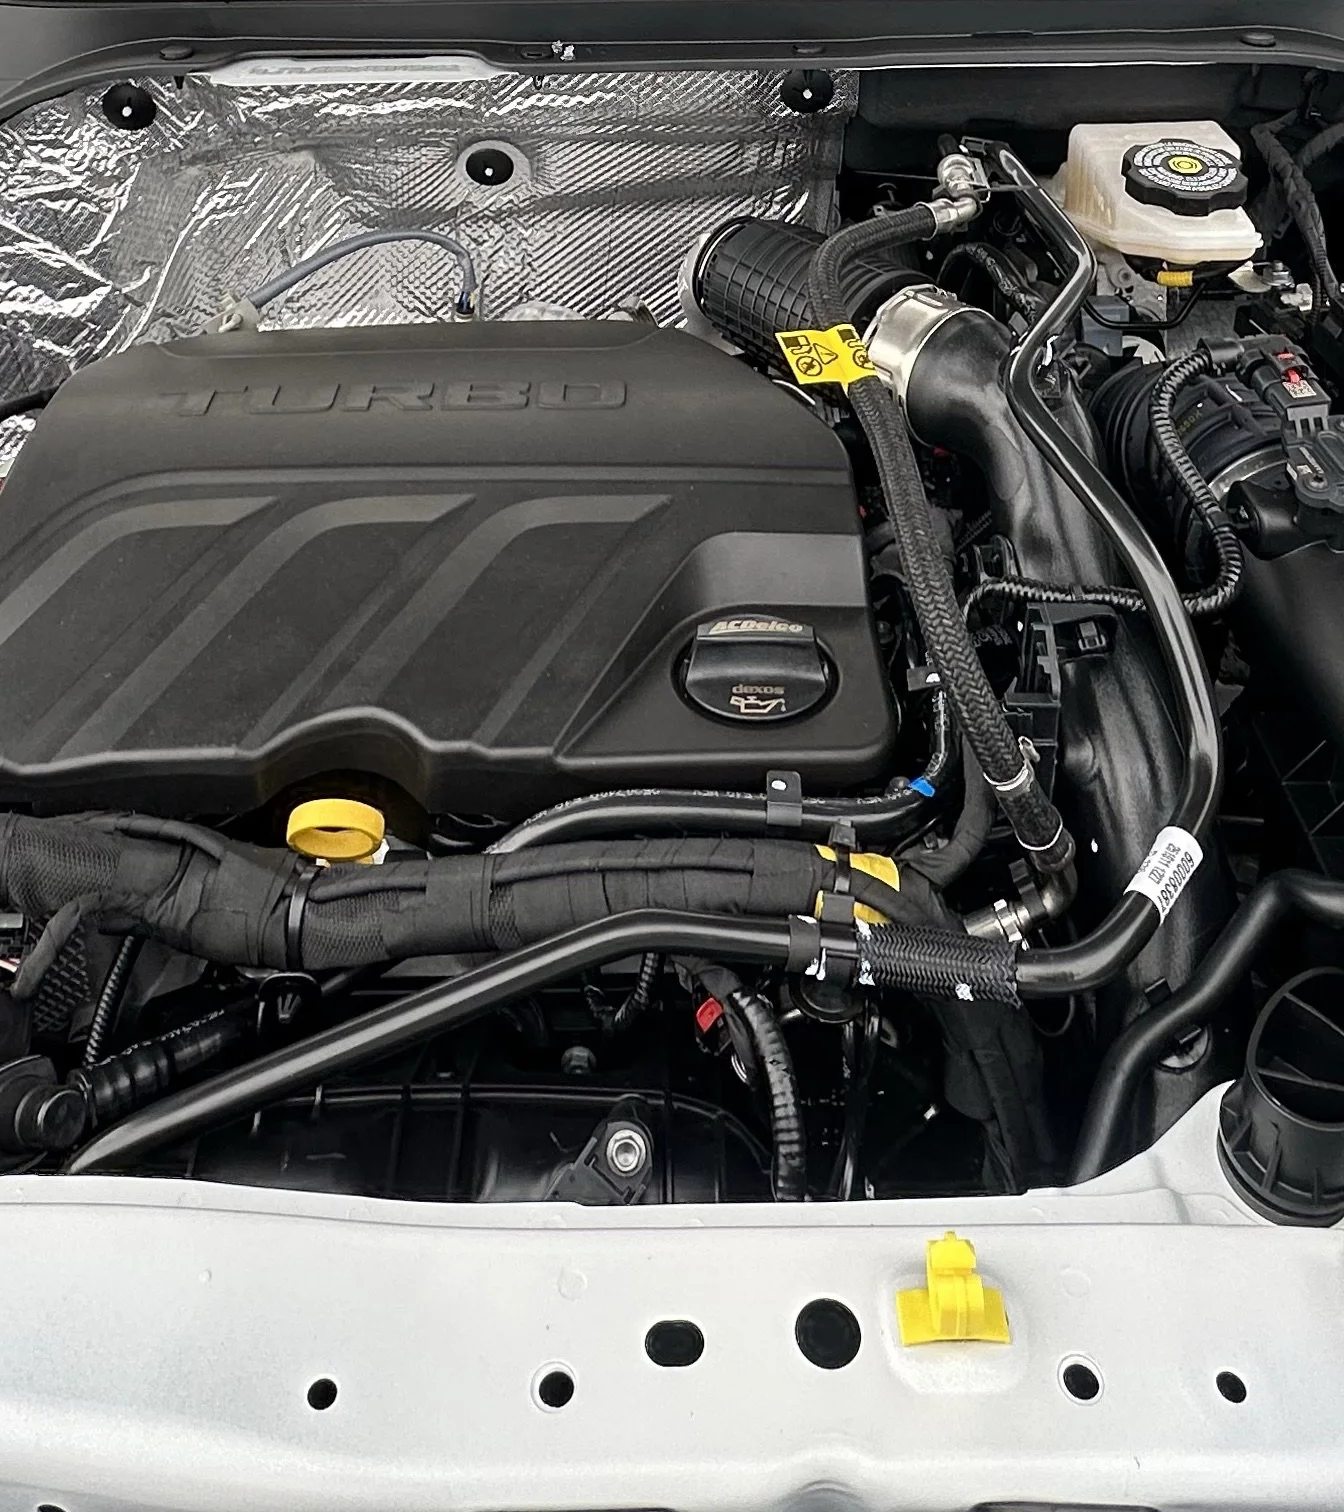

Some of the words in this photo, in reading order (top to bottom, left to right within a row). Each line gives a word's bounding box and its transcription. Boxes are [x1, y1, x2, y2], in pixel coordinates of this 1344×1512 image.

[159, 381, 629, 417] TURBO
[709, 619, 804, 635] ACDelco
[731, 683, 785, 696] dexos
